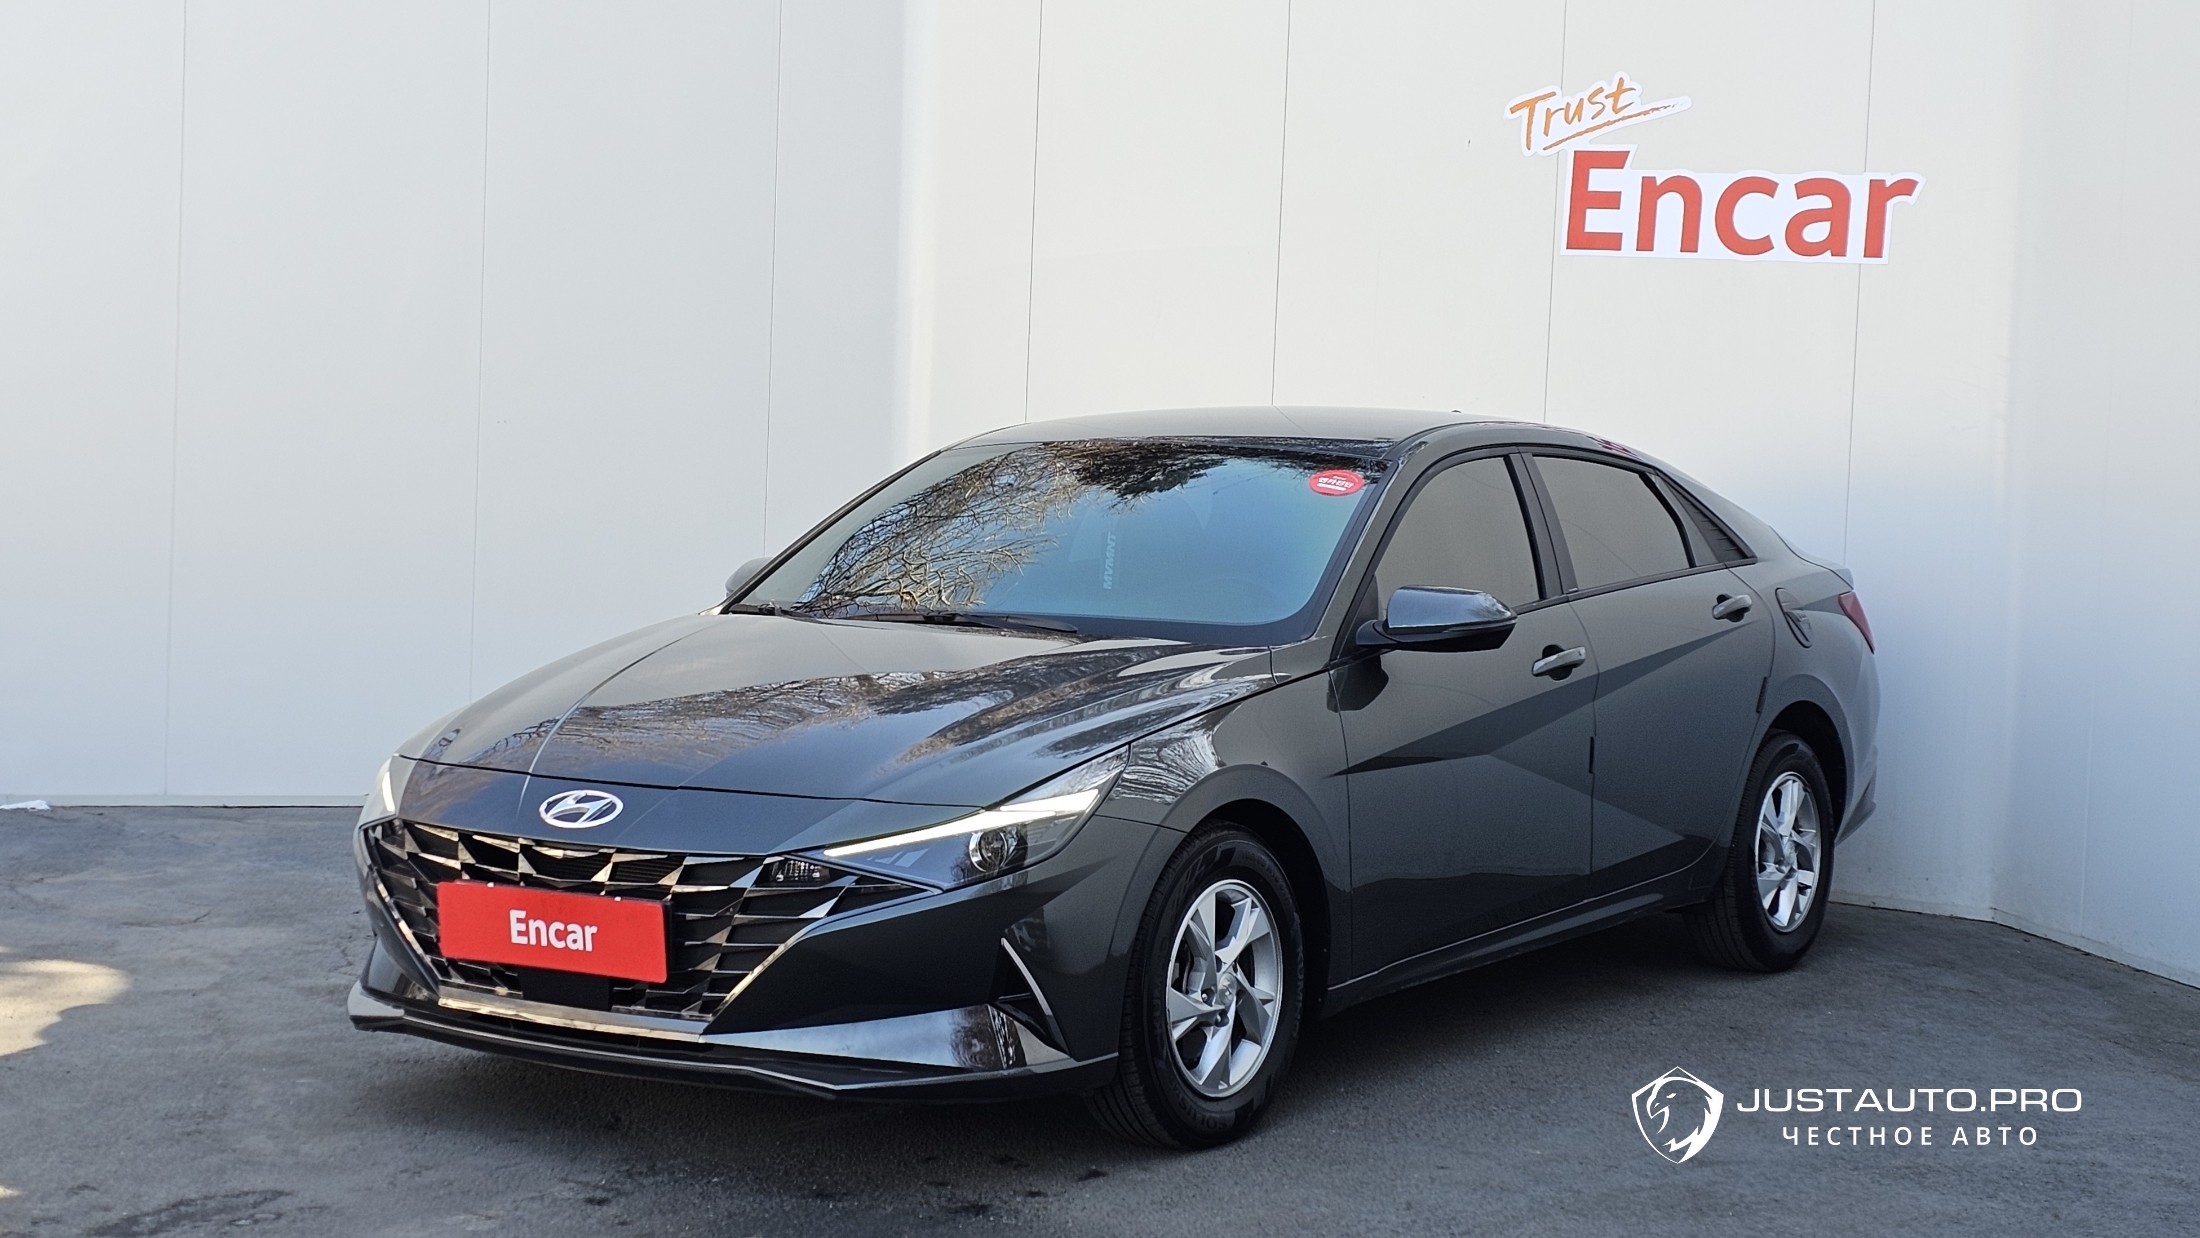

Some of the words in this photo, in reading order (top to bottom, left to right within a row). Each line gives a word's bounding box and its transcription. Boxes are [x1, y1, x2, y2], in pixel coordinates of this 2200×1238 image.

[1509, 77, 1636, 151] Trust
[1566, 149, 1920, 258] Encar
[509, 909, 598, 952] Encar
